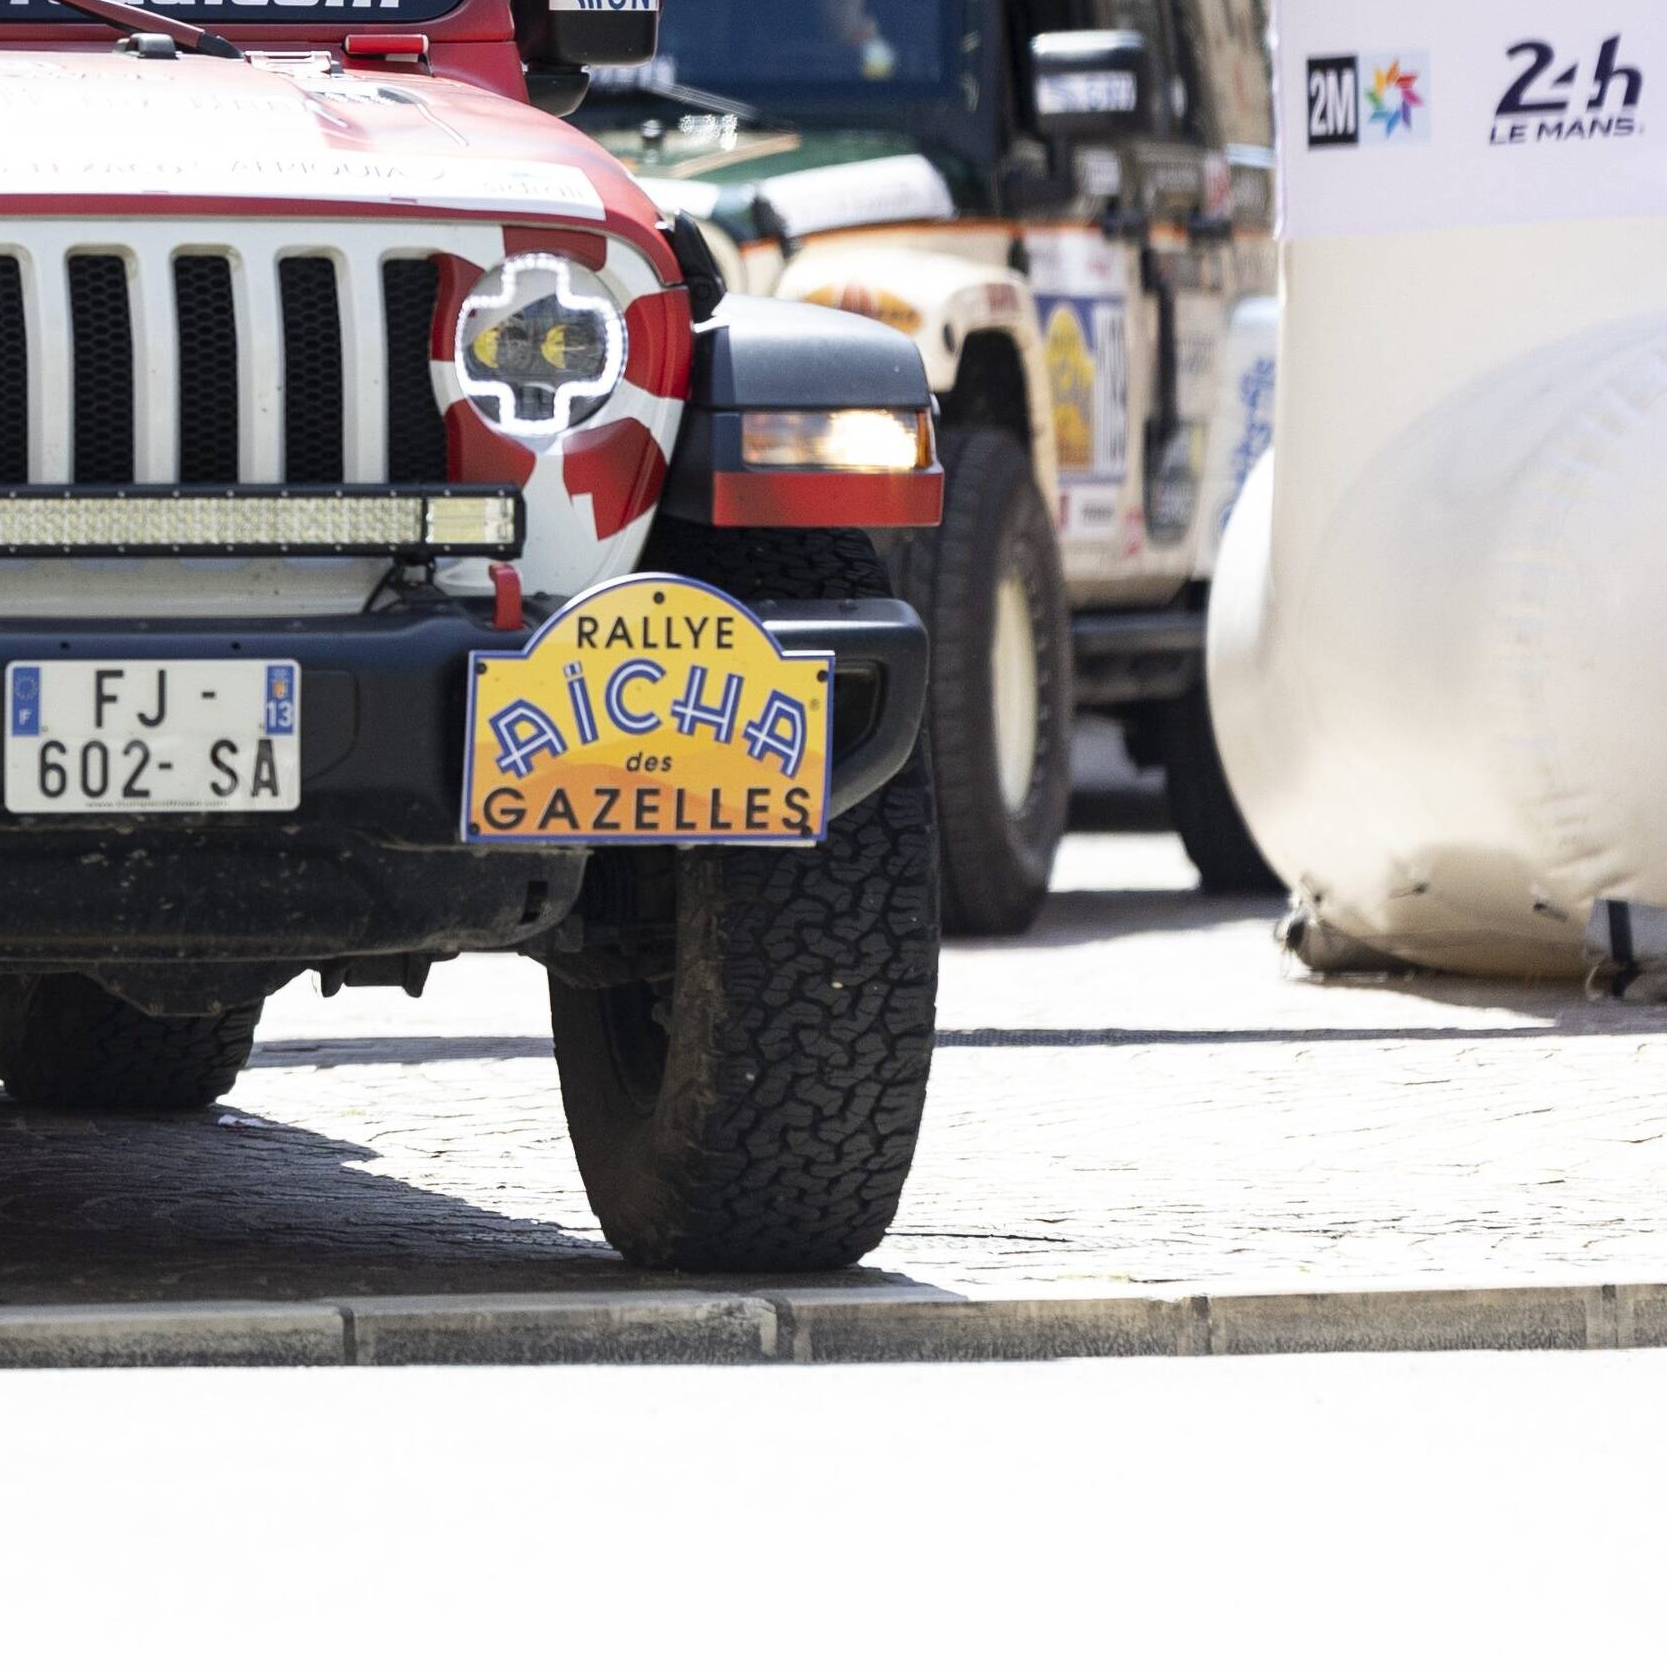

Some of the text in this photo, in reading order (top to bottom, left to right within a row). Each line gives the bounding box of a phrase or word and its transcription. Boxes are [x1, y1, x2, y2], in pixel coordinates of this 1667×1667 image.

[1494, 33, 1643, 116] 24h
[1310, 68, 1357, 136] 2M
[1489, 117, 1634, 145] LE MANS
[576, 615, 735, 650] RALLYE
[18, 708, 31, 726] F
[266, 701, 294, 728] 13
[487, 656, 808, 780] AÏCHA
[625, 751, 673, 773] des
[482, 785, 812, 832] GAZELLES
